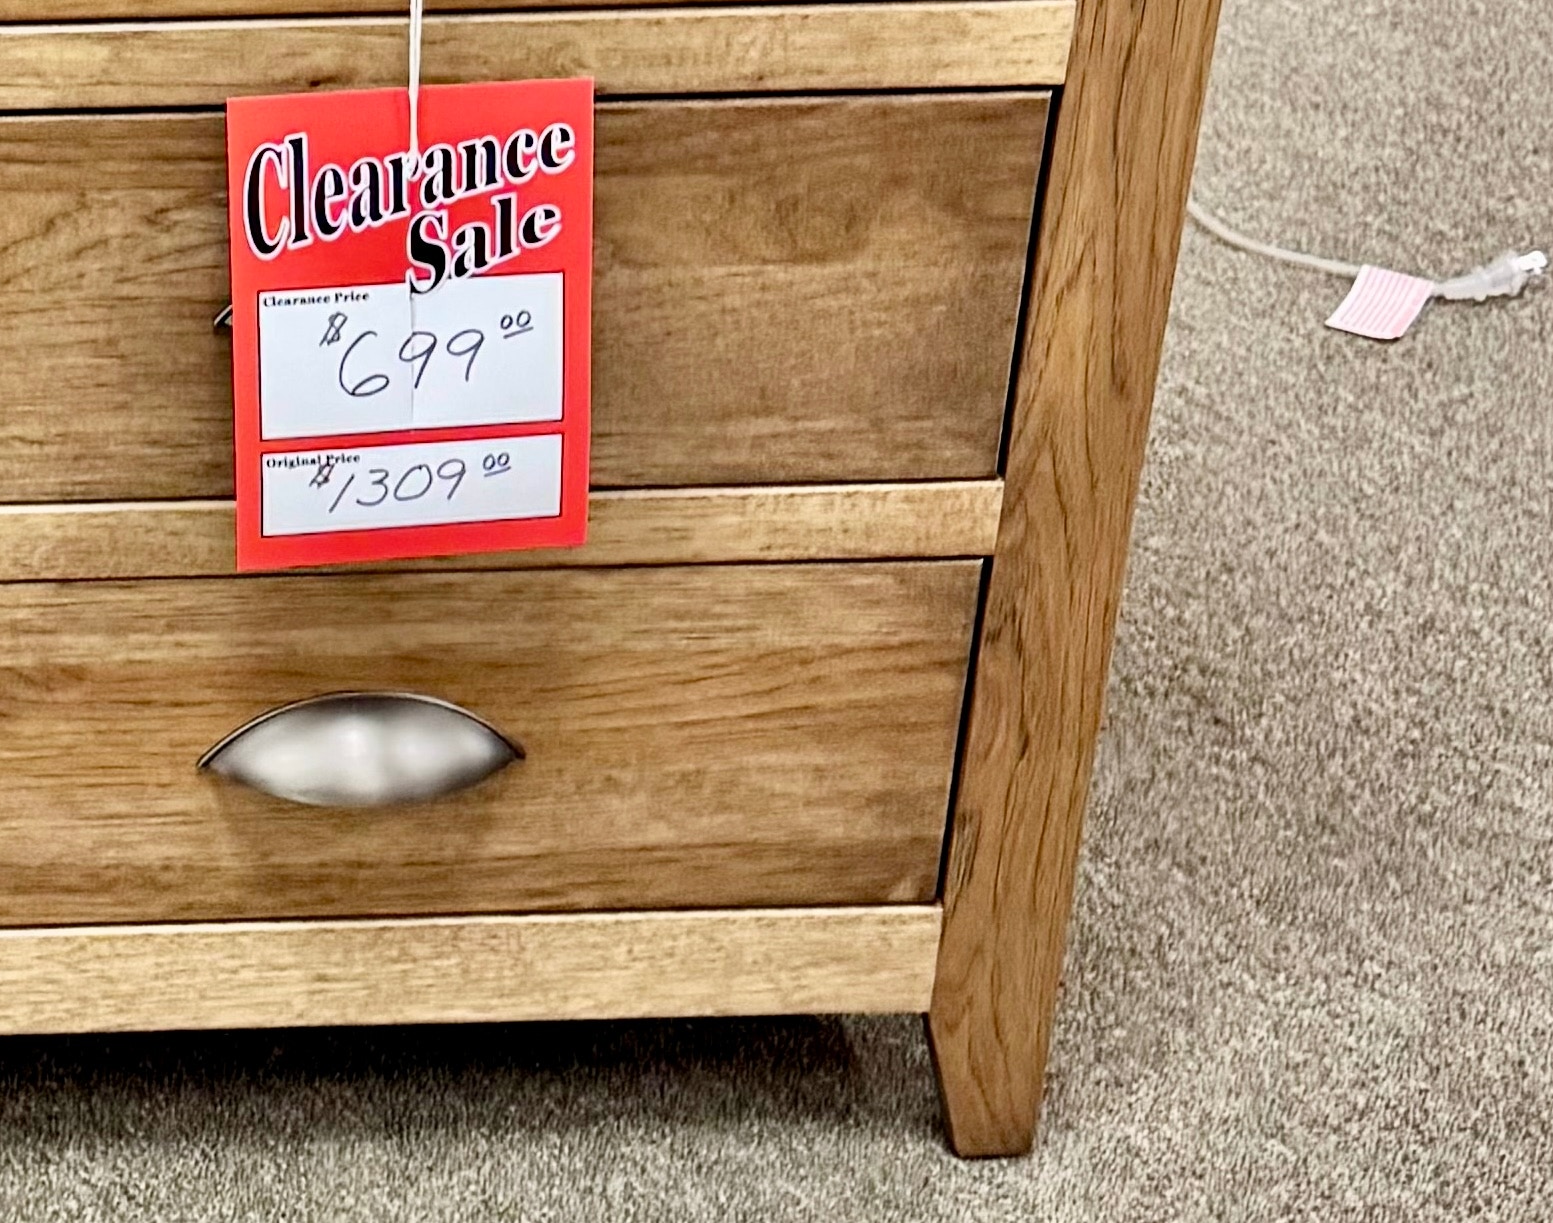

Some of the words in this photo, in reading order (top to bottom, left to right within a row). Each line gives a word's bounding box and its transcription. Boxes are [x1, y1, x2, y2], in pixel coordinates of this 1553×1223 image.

[245, 124, 573, 258] Clearance
[407, 196, 561, 296] Sale
[262, 293, 332, 308] Clearance
[334, 291, 370, 304] Price
[266, 454, 321, 469] Original
[325, 453, 361, 466] Price
